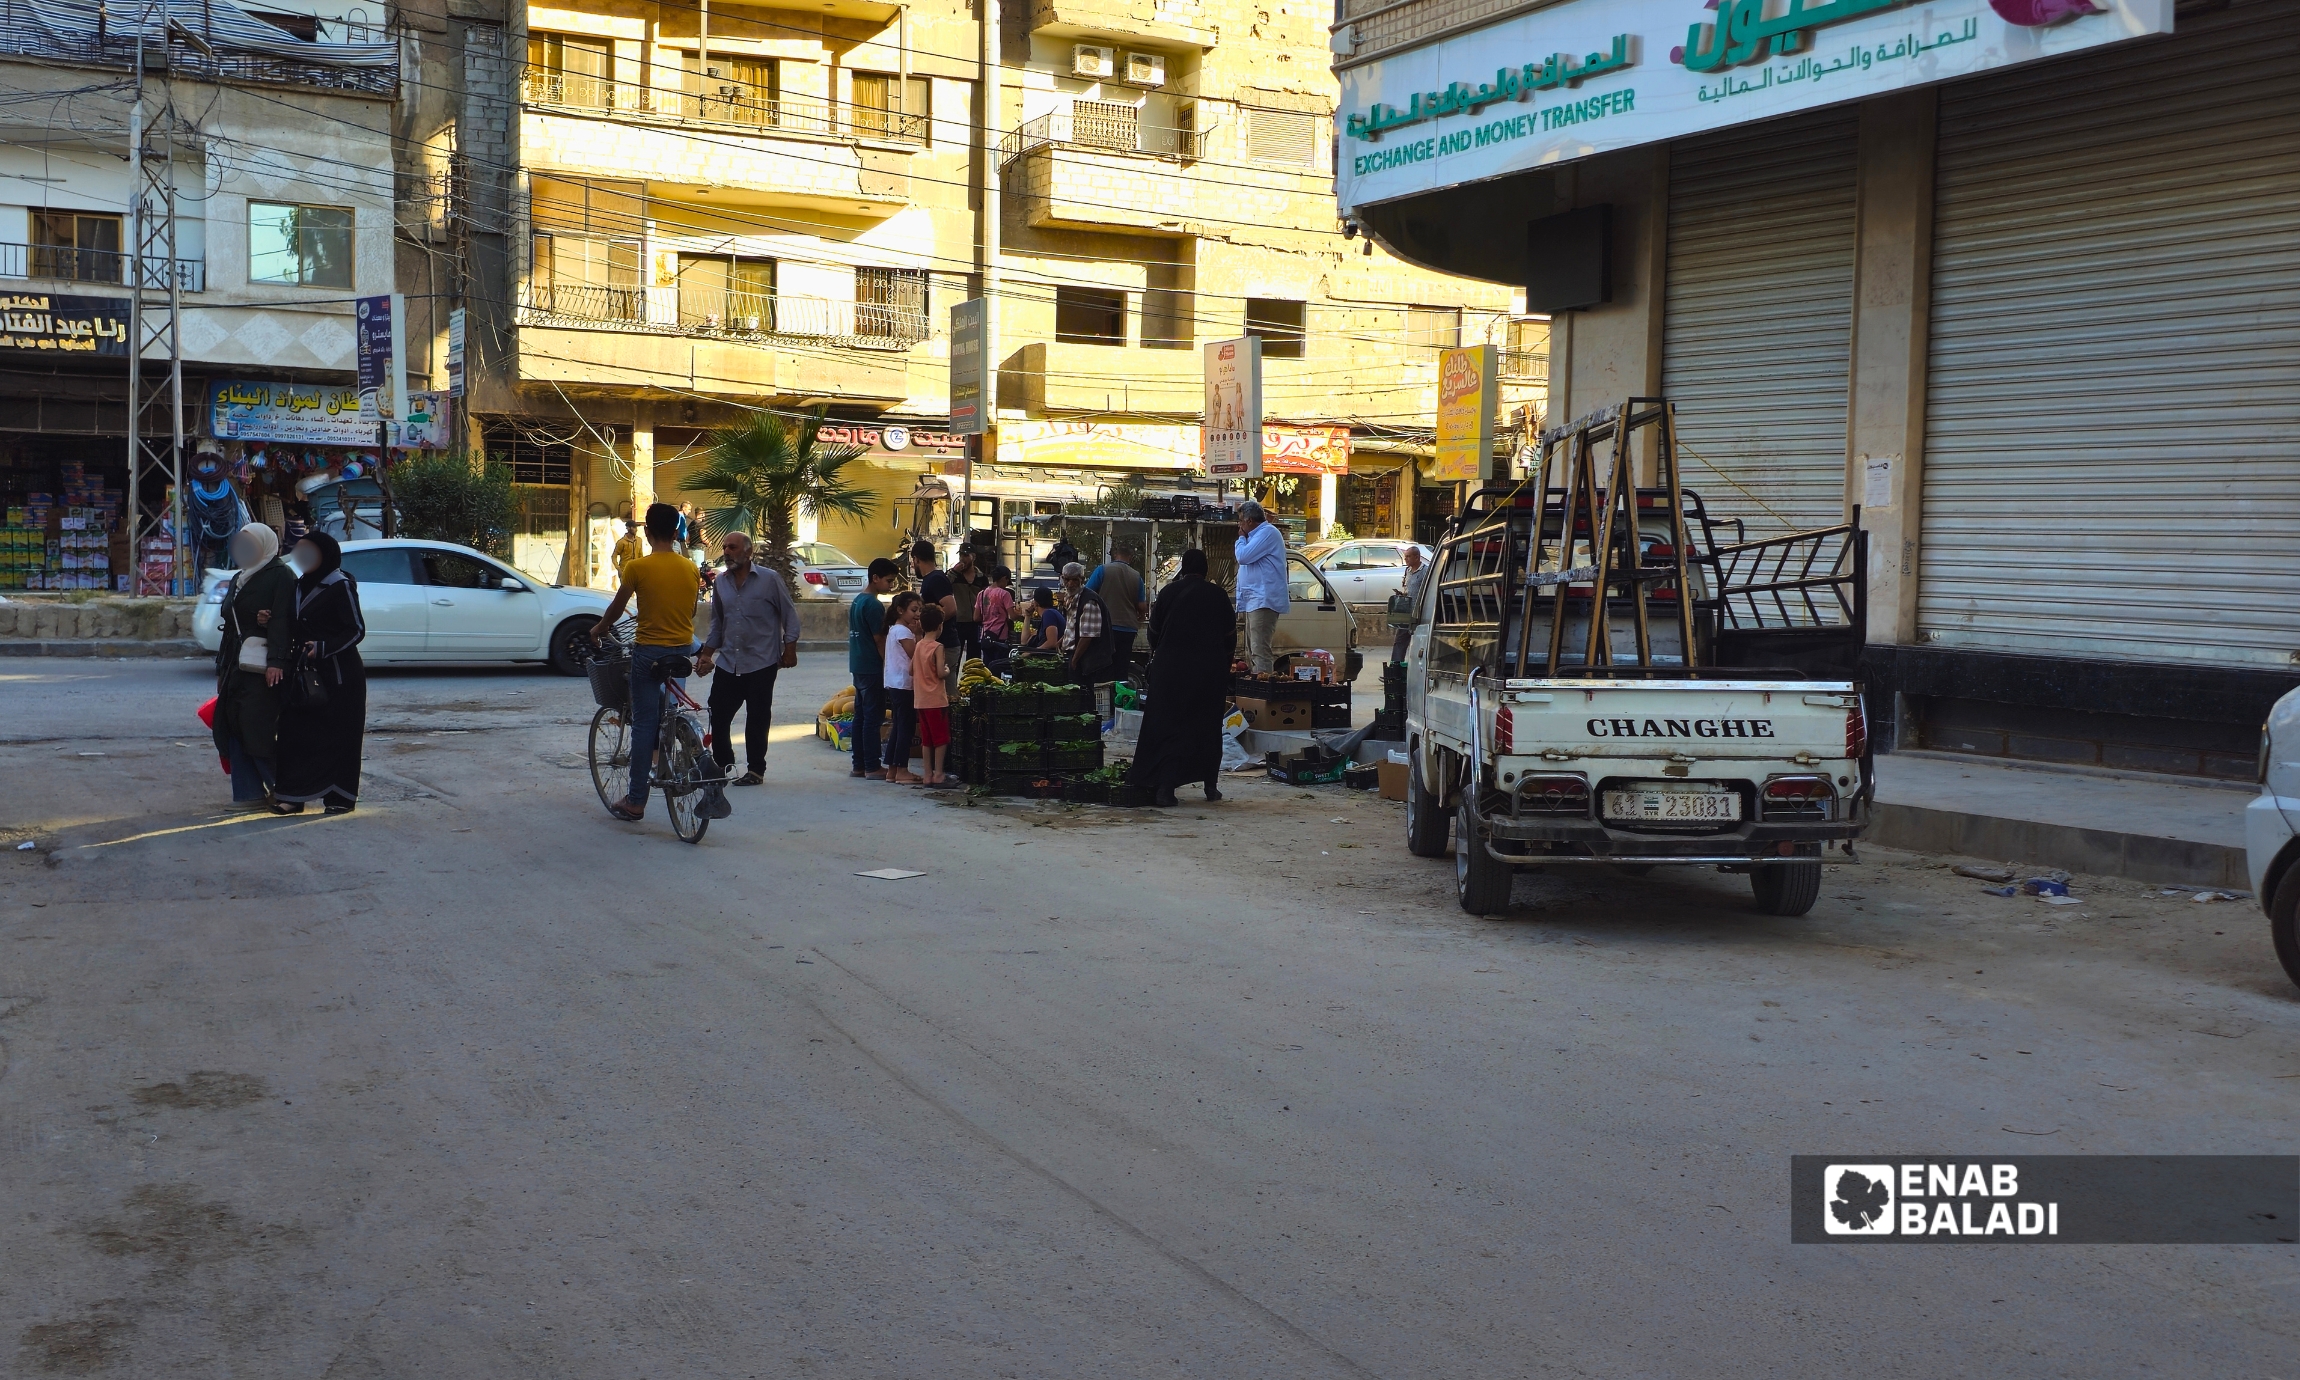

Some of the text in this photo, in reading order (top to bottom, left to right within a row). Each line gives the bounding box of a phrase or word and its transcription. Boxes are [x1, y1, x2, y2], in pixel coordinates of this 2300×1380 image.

[1698, 17, 1977, 103] للصرافة والحوالات المالية
[1346, 33, 1627, 141] للصرافة والحوالات المالية
[1355, 88, 1635, 176] EXCHANGE AND MONEY TRANSFER
[0, 295, 50, 310] الدكتو
[56, 318, 93, 338] عبد
[215, 383, 270, 411] البناء
[275, 388, 322, 413] لمواد
[326, 390, 359, 415] طان
[1586, 718, 1775, 738] CHANGHE
[1612, 795, 1732, 817] 61 23081
